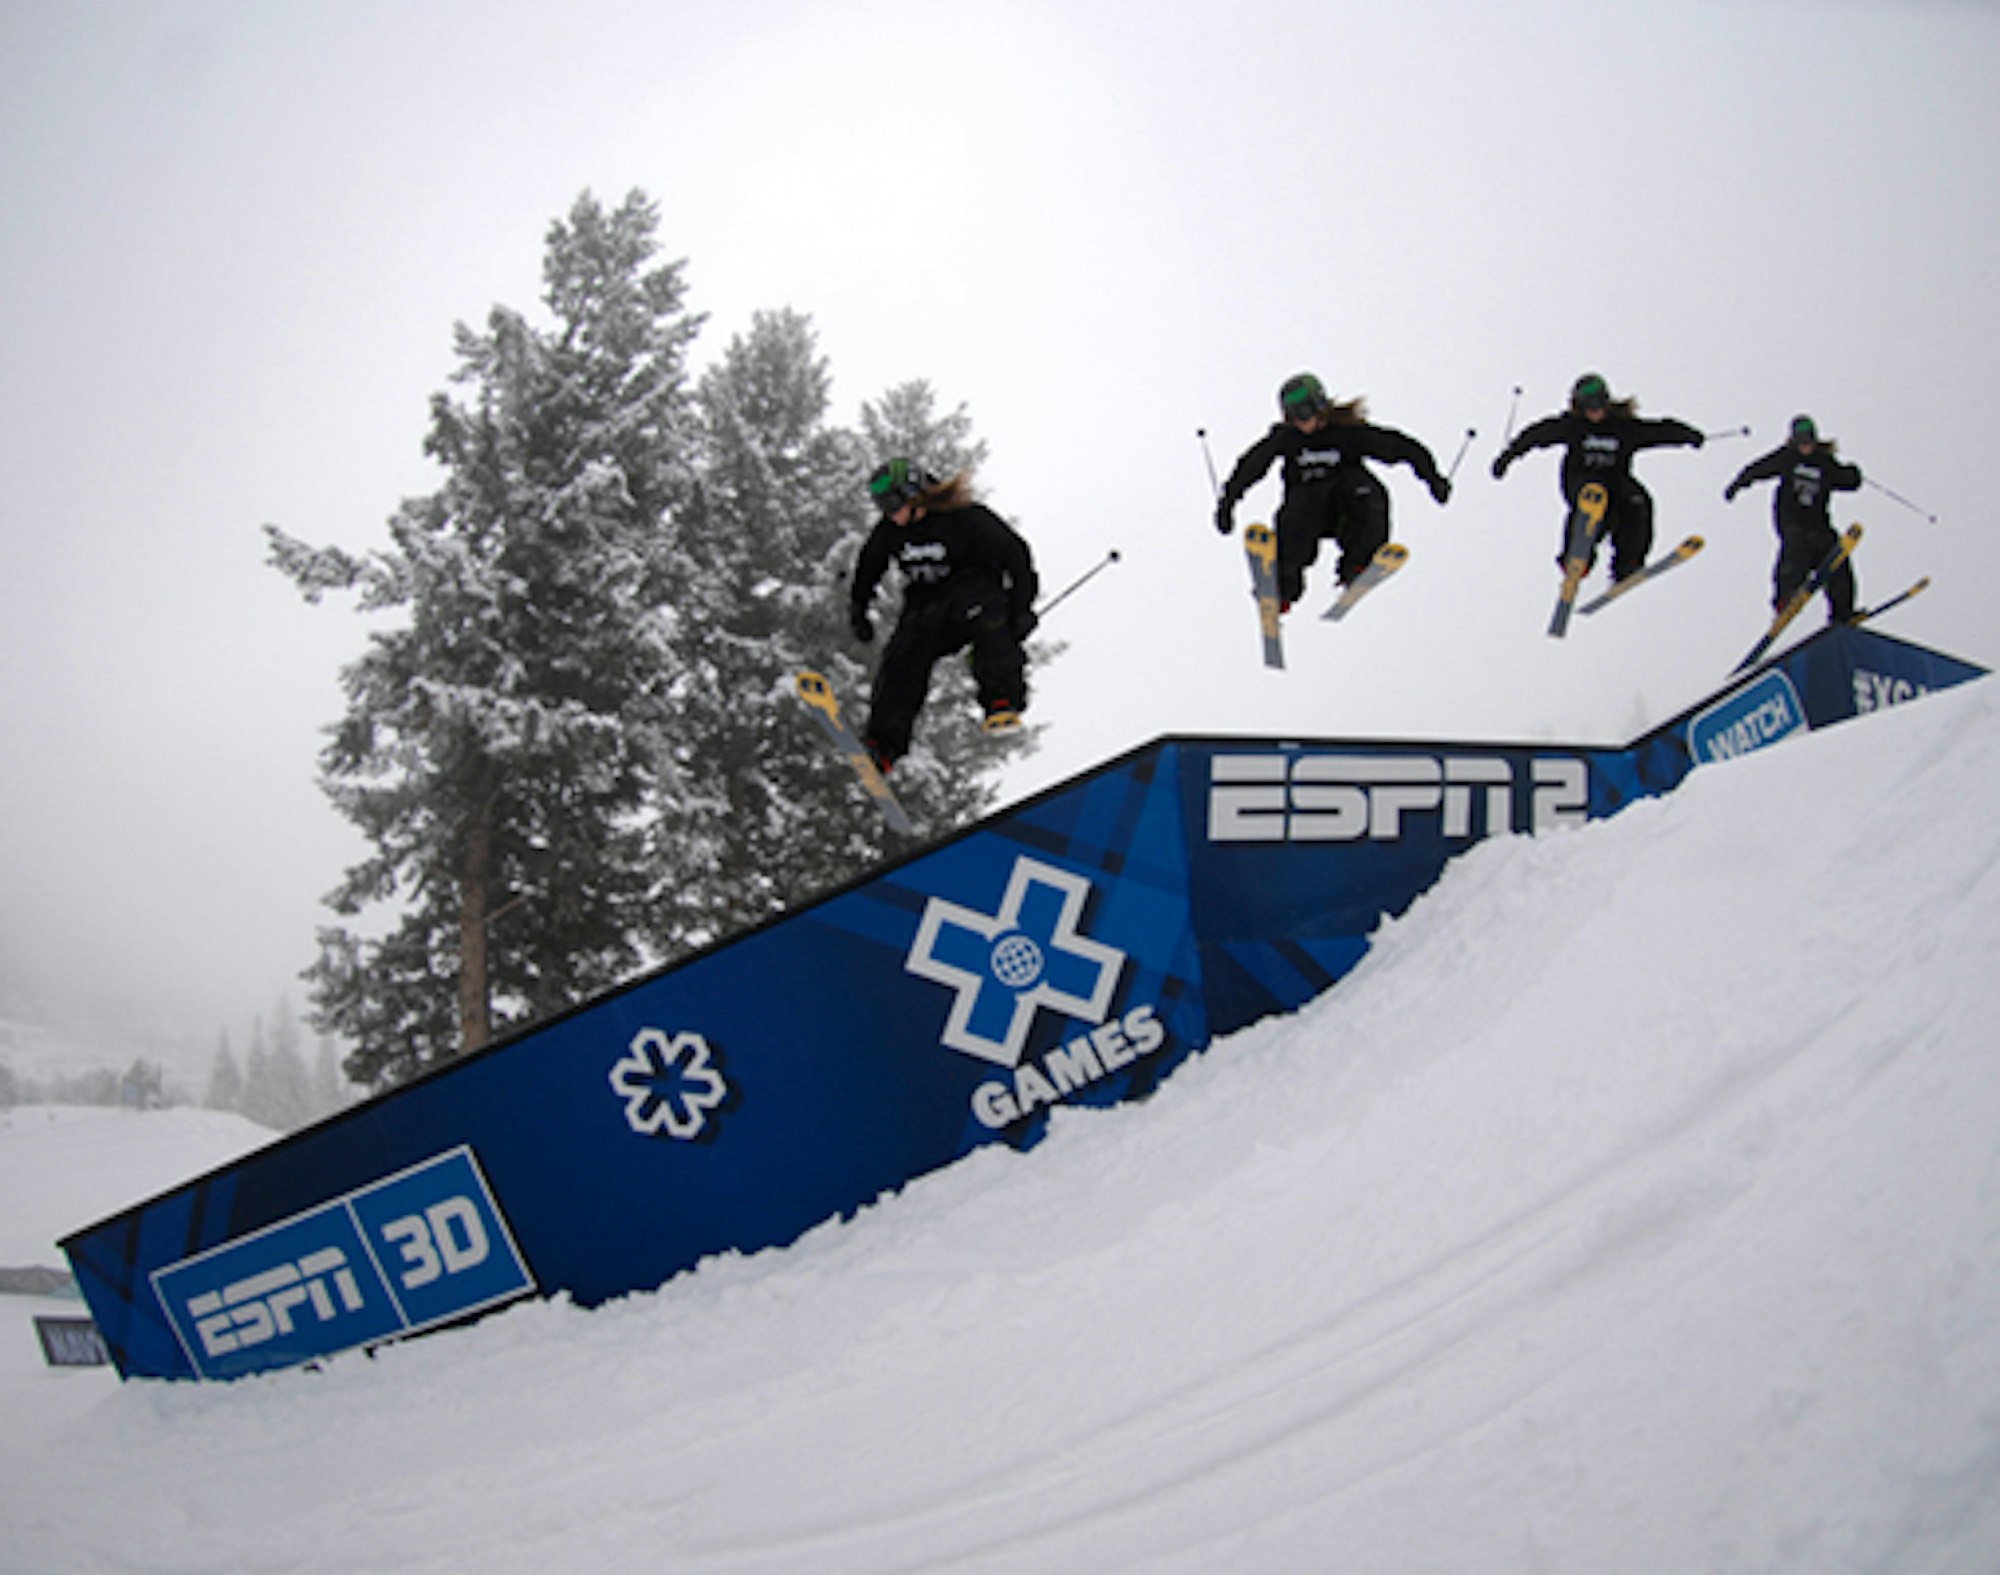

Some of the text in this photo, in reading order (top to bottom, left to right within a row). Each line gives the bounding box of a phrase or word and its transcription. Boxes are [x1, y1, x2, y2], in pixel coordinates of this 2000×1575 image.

[1707, 694, 1792, 763] WATCH
[904, 854, 1126, 1068] X
[970, 1005, 1165, 1129] GAMES
[188, 1196, 489, 1358] ESPN 3D
